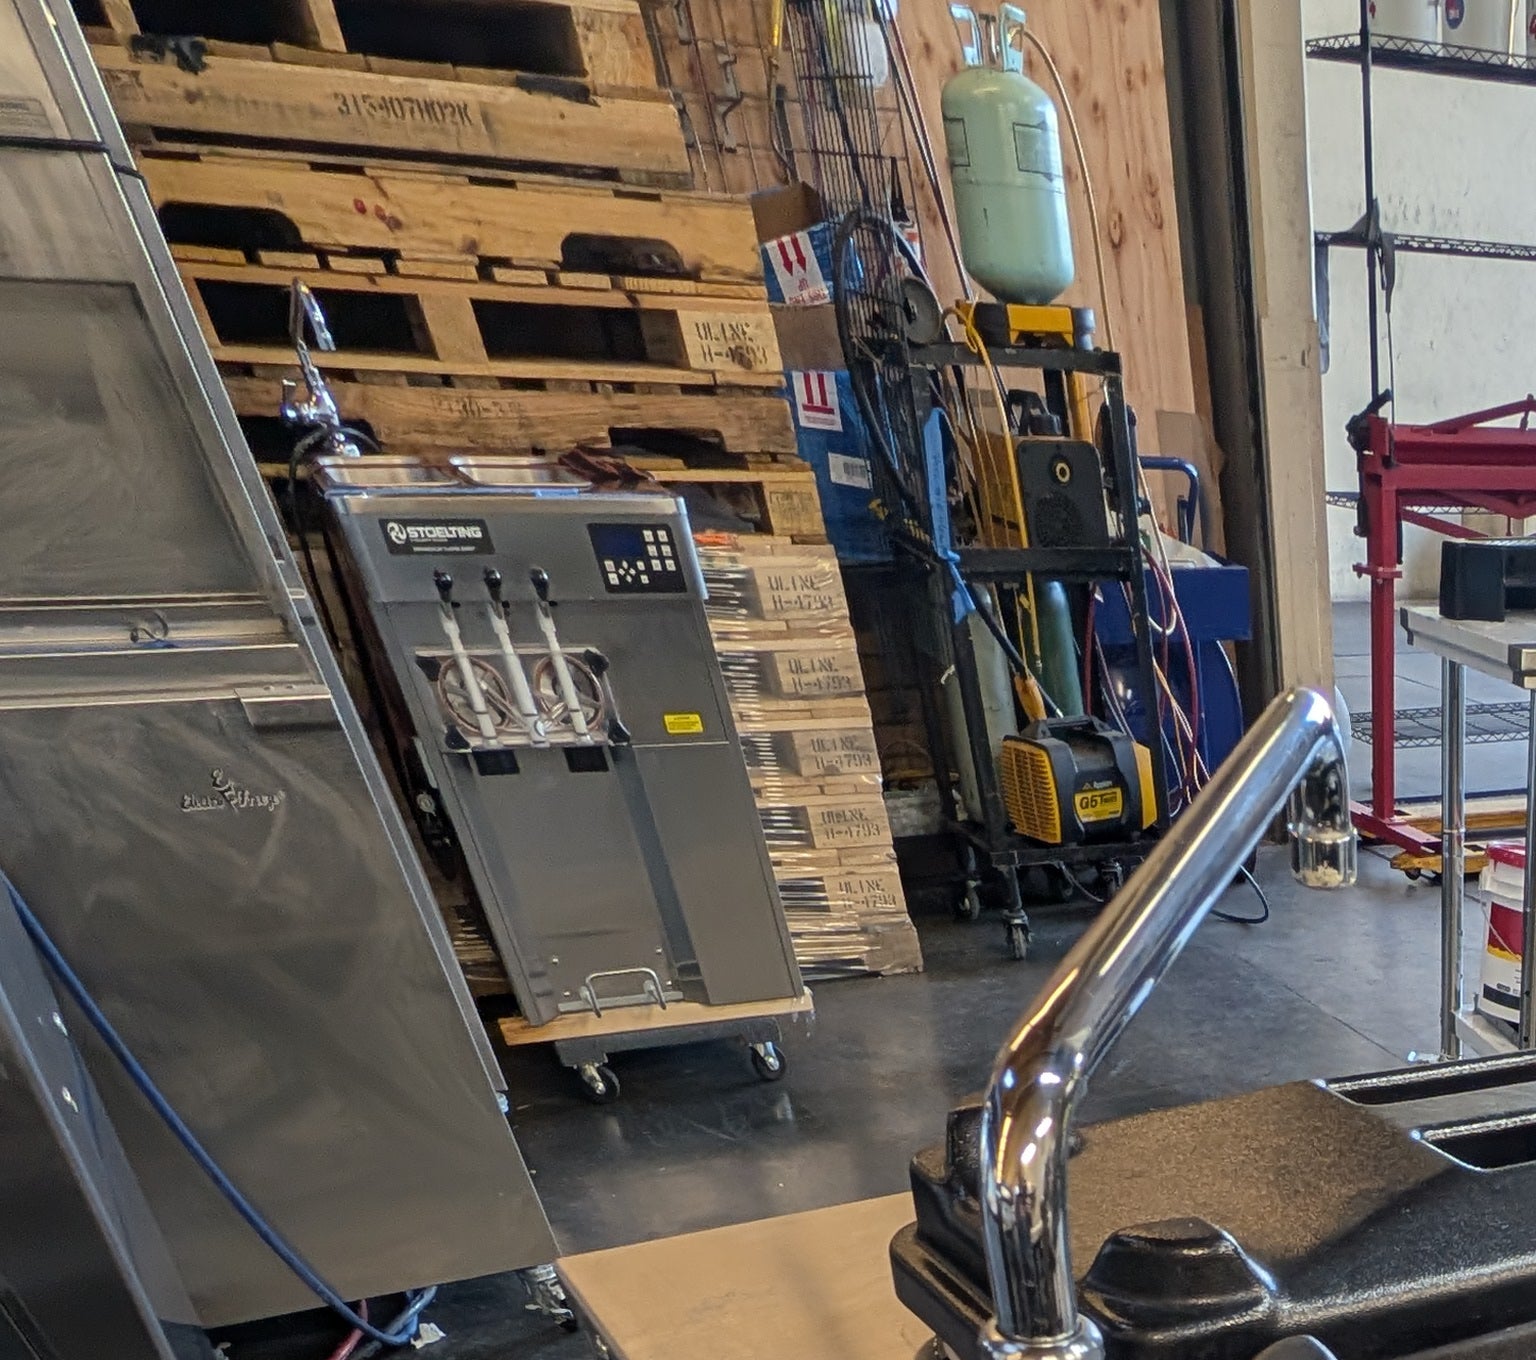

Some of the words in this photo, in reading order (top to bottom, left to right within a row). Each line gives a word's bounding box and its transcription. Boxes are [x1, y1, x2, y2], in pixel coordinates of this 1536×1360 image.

[406, 526, 483, 539] STOELTING
[767, 575, 821, 591] ULINE
[788, 656, 839, 674] ULINE
[810, 735, 860, 753] ULINE
[821, 808, 869, 825] ULINE
[838, 878, 886, 894] ULINE
